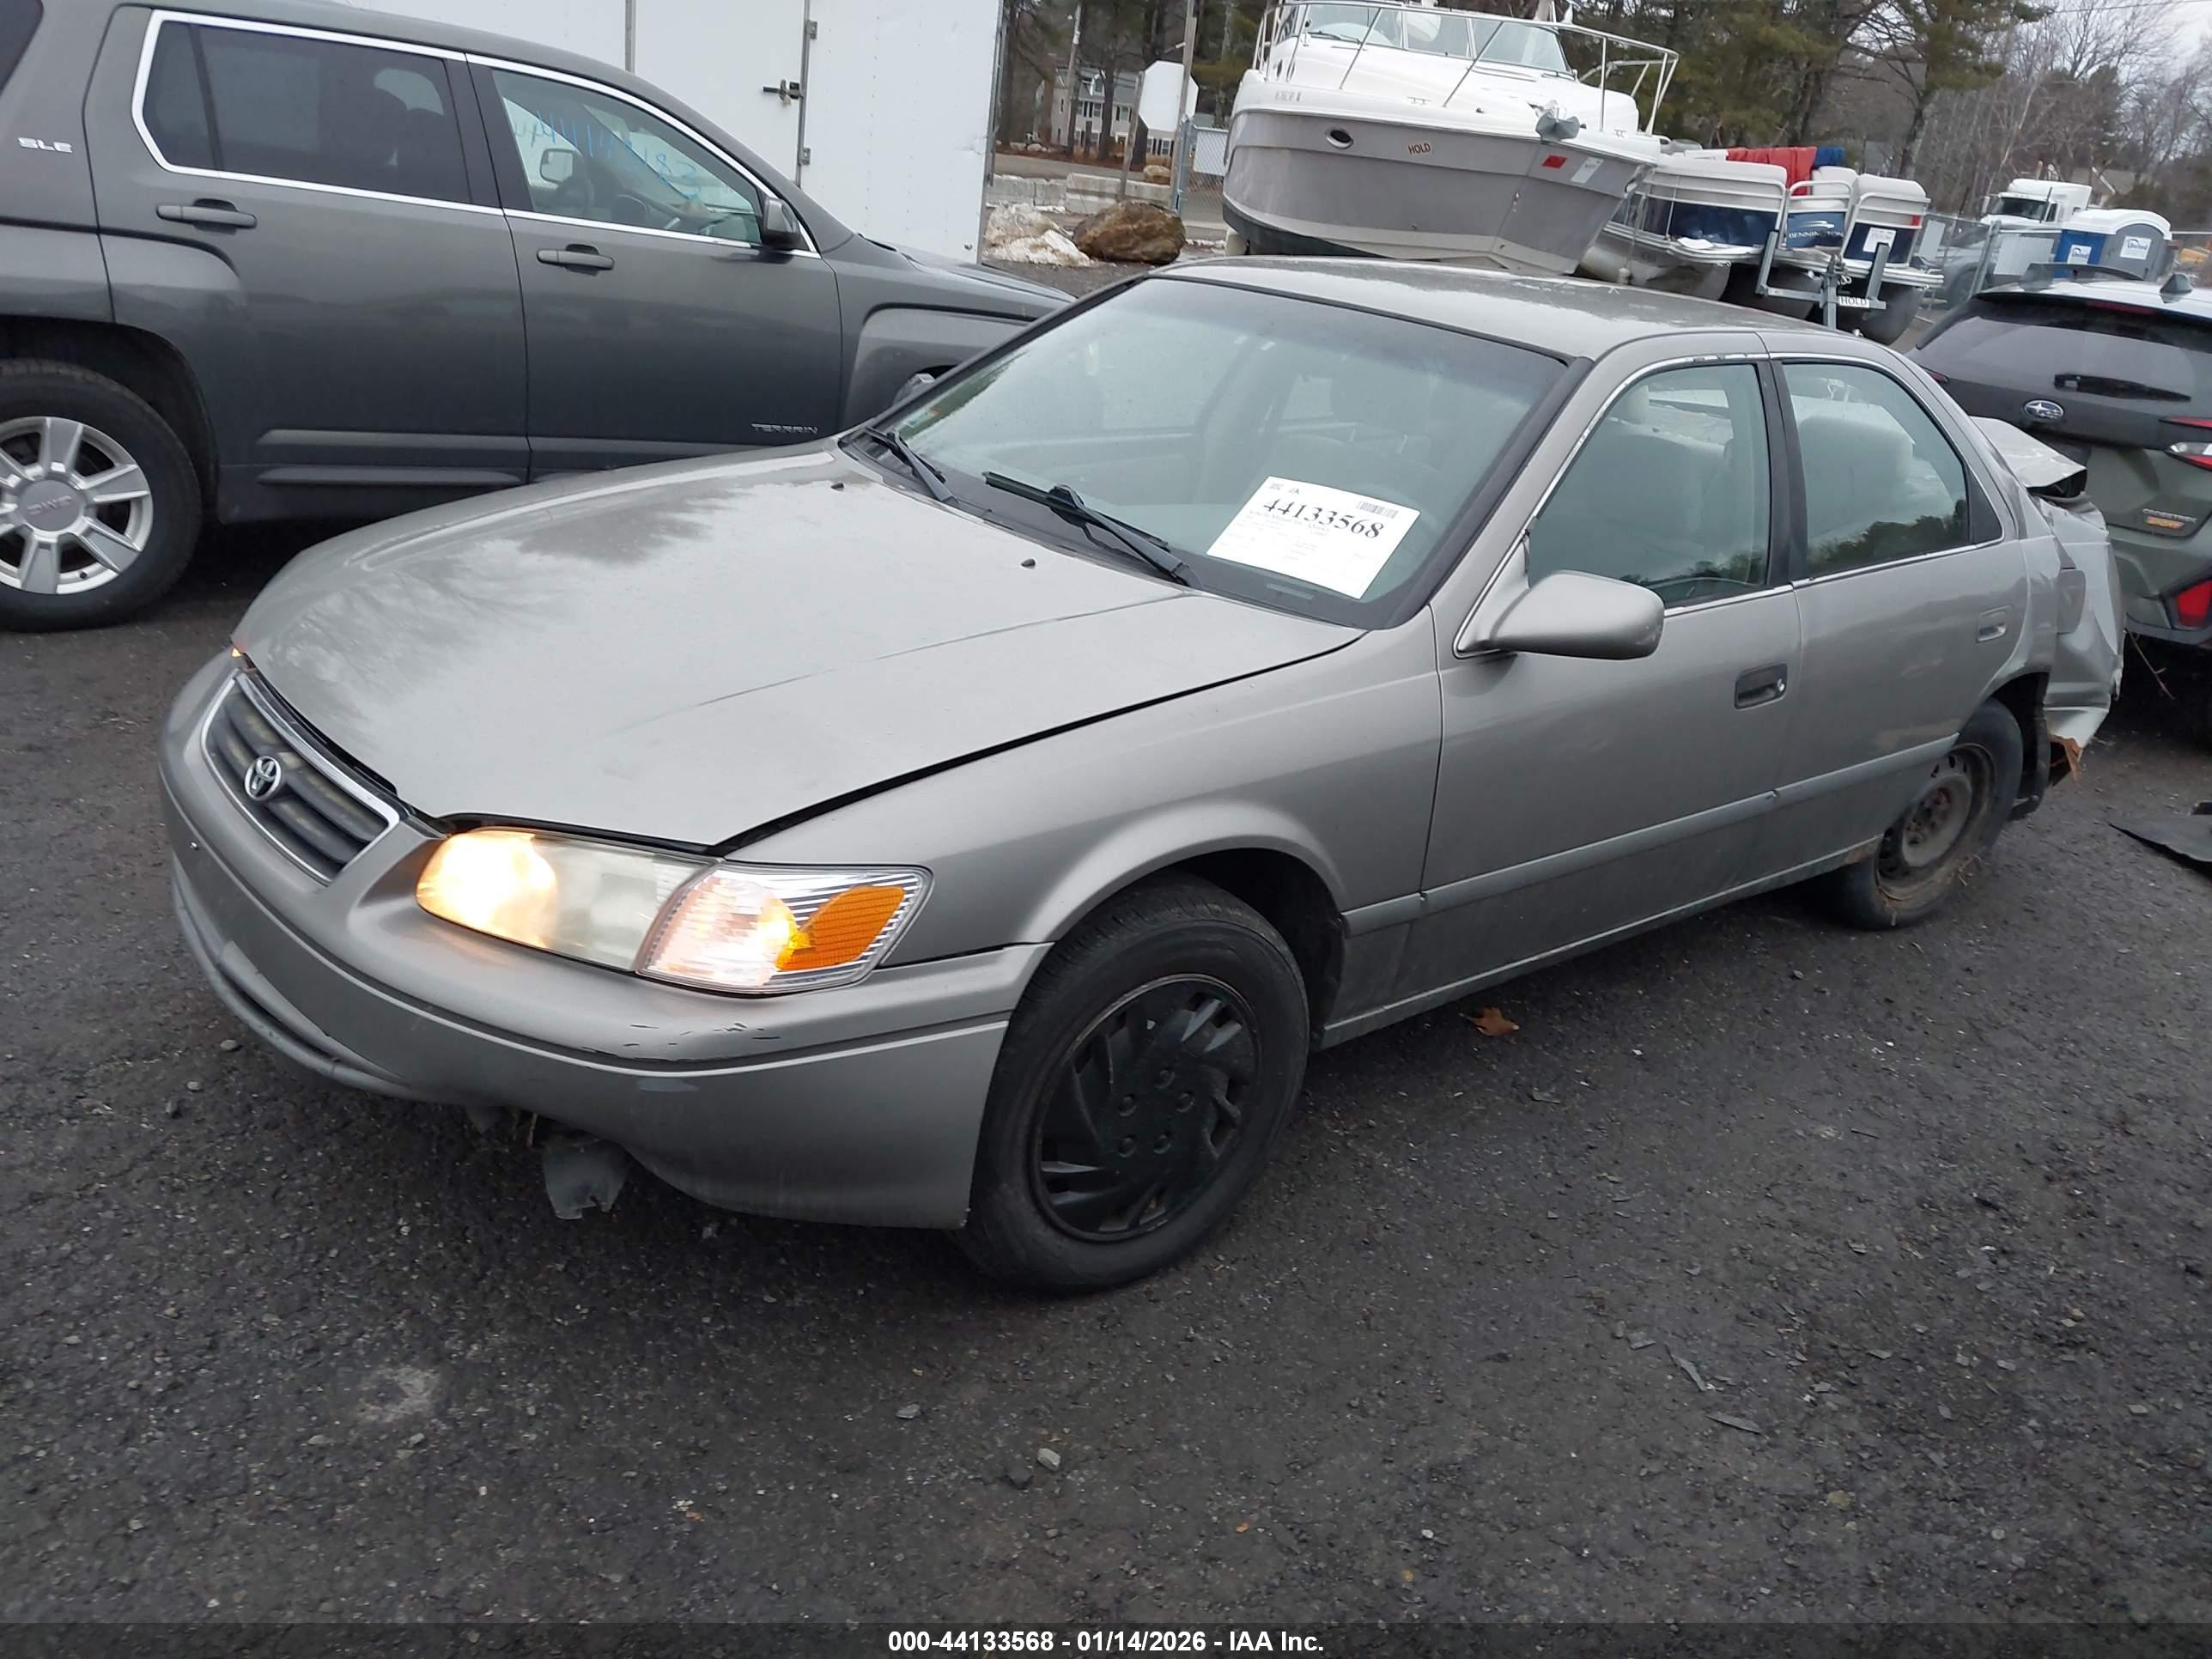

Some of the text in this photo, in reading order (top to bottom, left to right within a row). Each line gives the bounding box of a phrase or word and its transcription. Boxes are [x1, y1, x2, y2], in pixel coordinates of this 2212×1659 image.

[18, 137, 72, 154] SLE
[1408, 143, 1431, 155] HOLD
[1841, 296, 1867, 307] HOLD
[1263, 498, 1384, 539] 44133568
